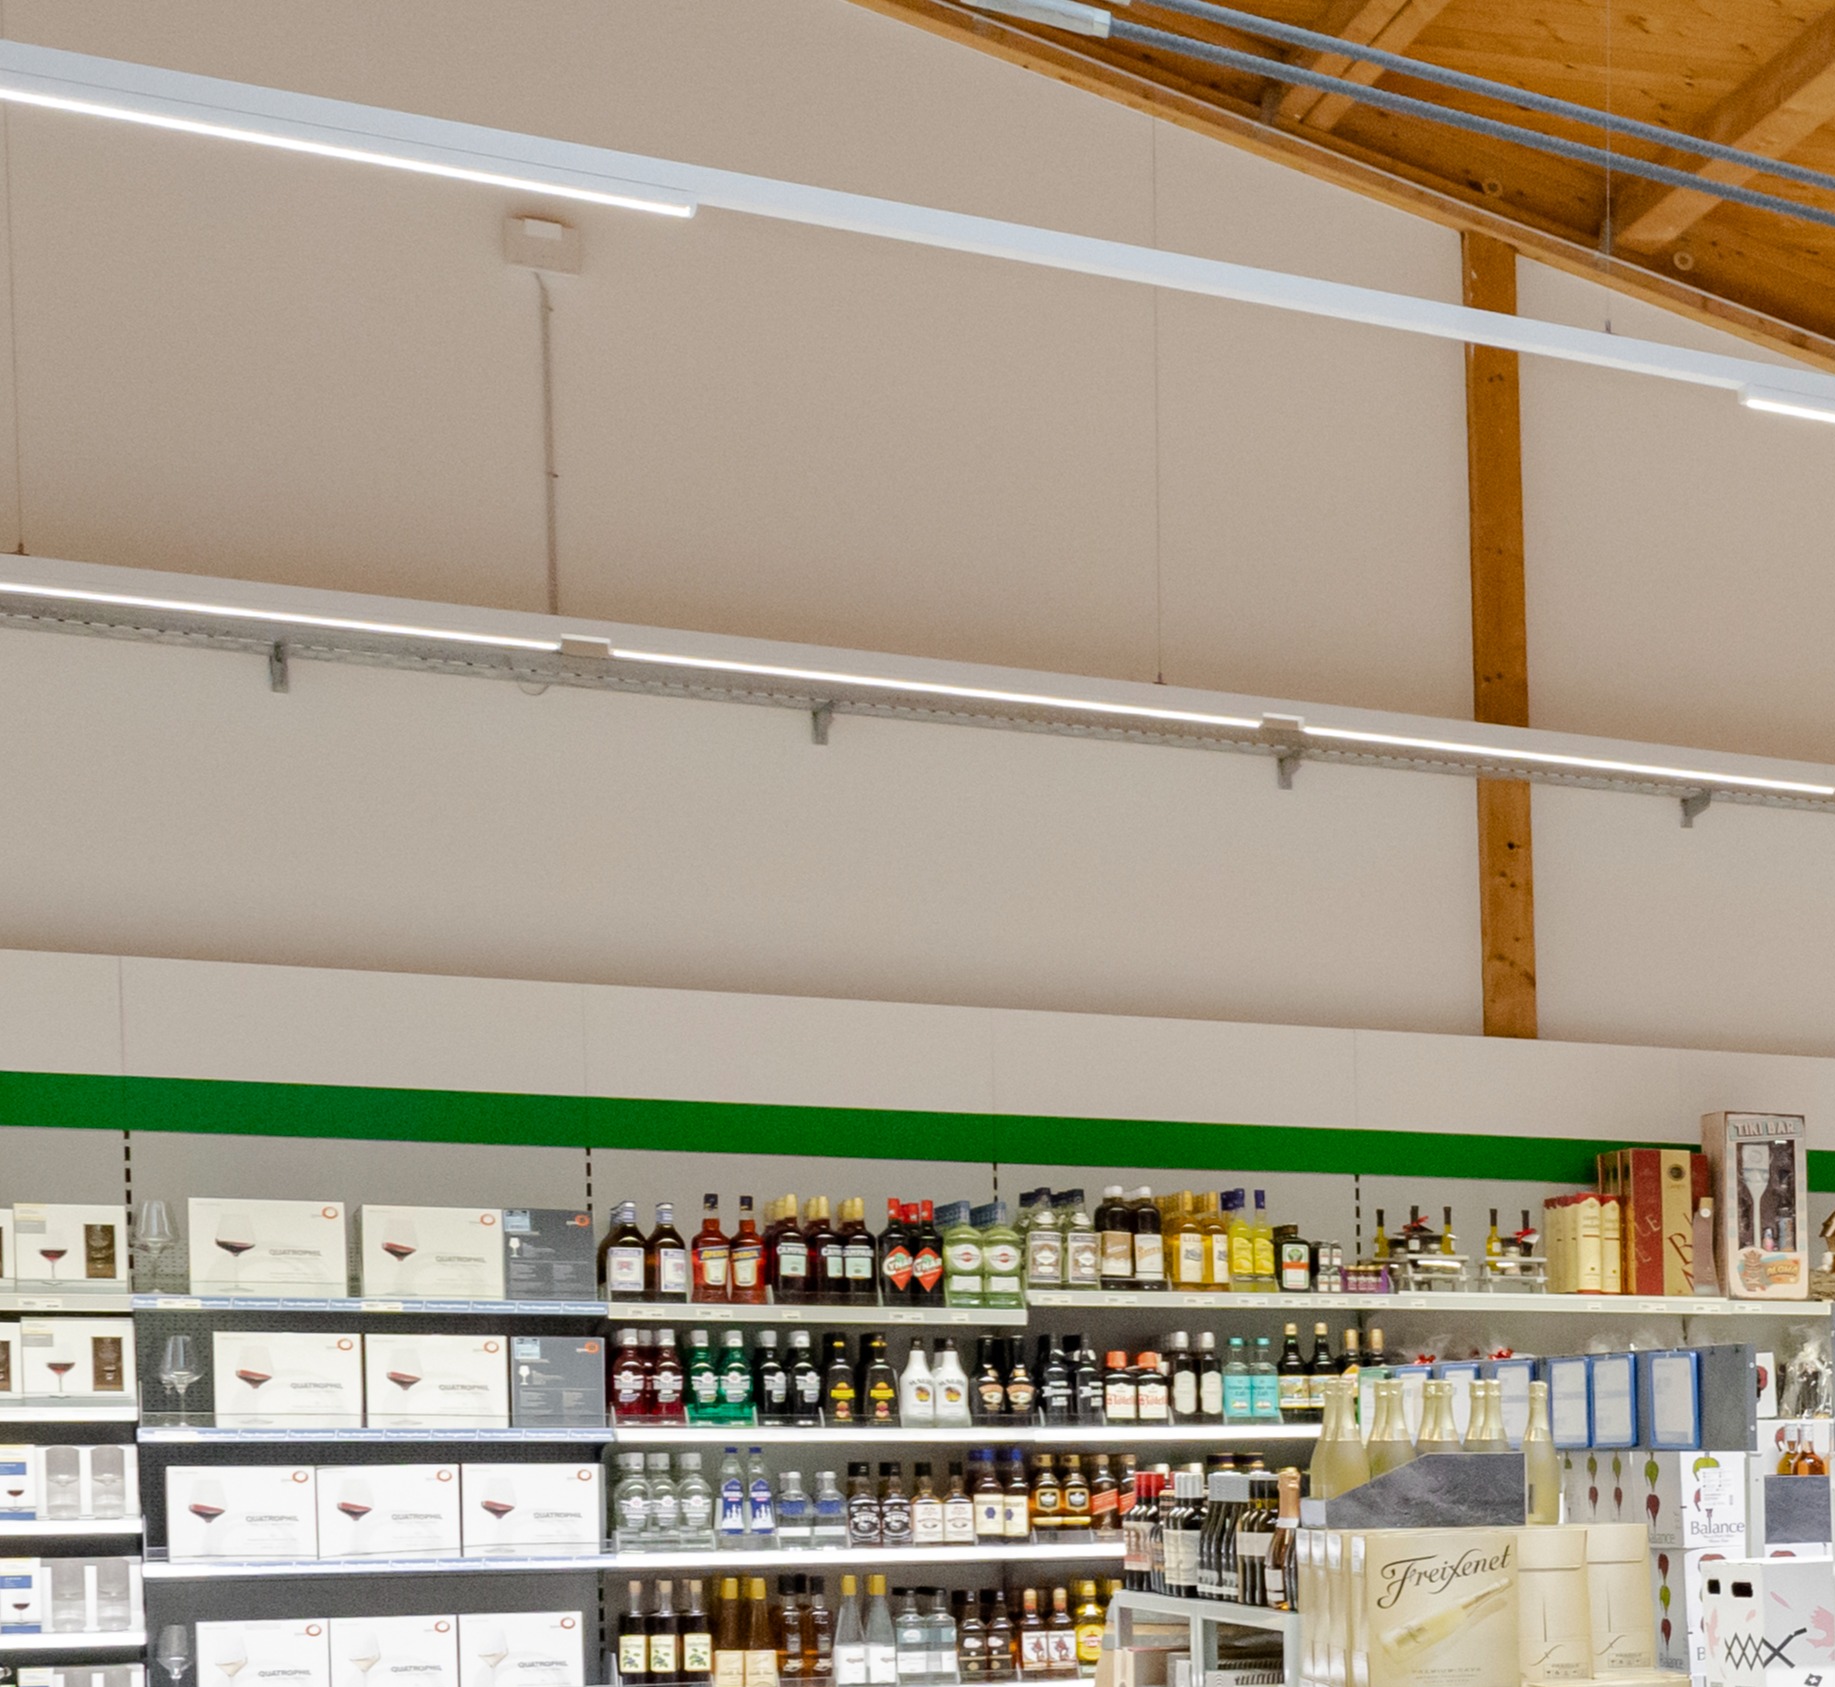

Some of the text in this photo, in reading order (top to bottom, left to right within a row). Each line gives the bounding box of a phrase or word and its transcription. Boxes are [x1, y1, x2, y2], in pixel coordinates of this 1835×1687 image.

[1734, 1121, 1795, 1136] TIKI BAR
[1690, 1521, 1745, 1536] Balance
[1375, 1542, 1513, 1611] Freixenet
